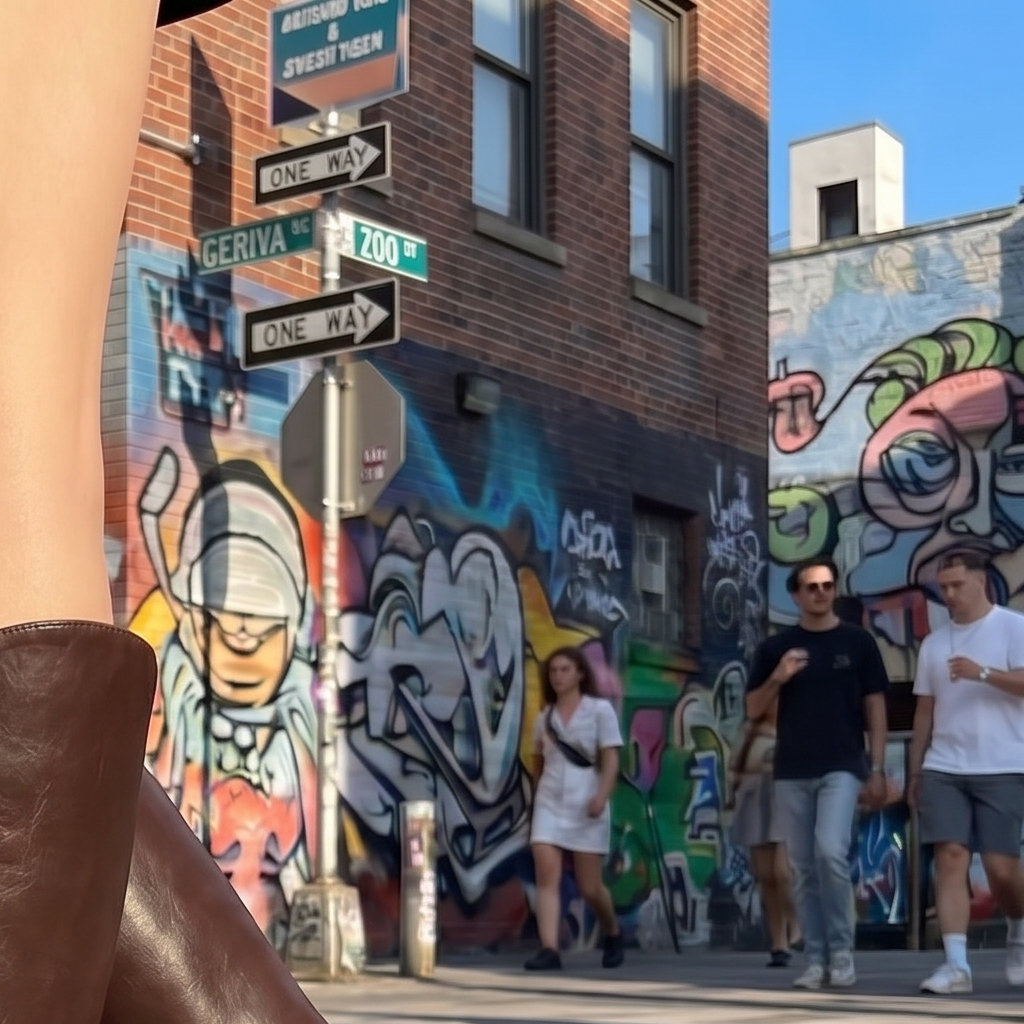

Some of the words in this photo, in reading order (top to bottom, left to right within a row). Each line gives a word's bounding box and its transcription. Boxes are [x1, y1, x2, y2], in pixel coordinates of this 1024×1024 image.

[270, 160, 311, 188] ONE
[326, 144, 369, 173] WAY
[202, 223, 288, 268] GERIVA
[263, 316, 307, 347] ONE
[326, 303, 373, 335] WAY
